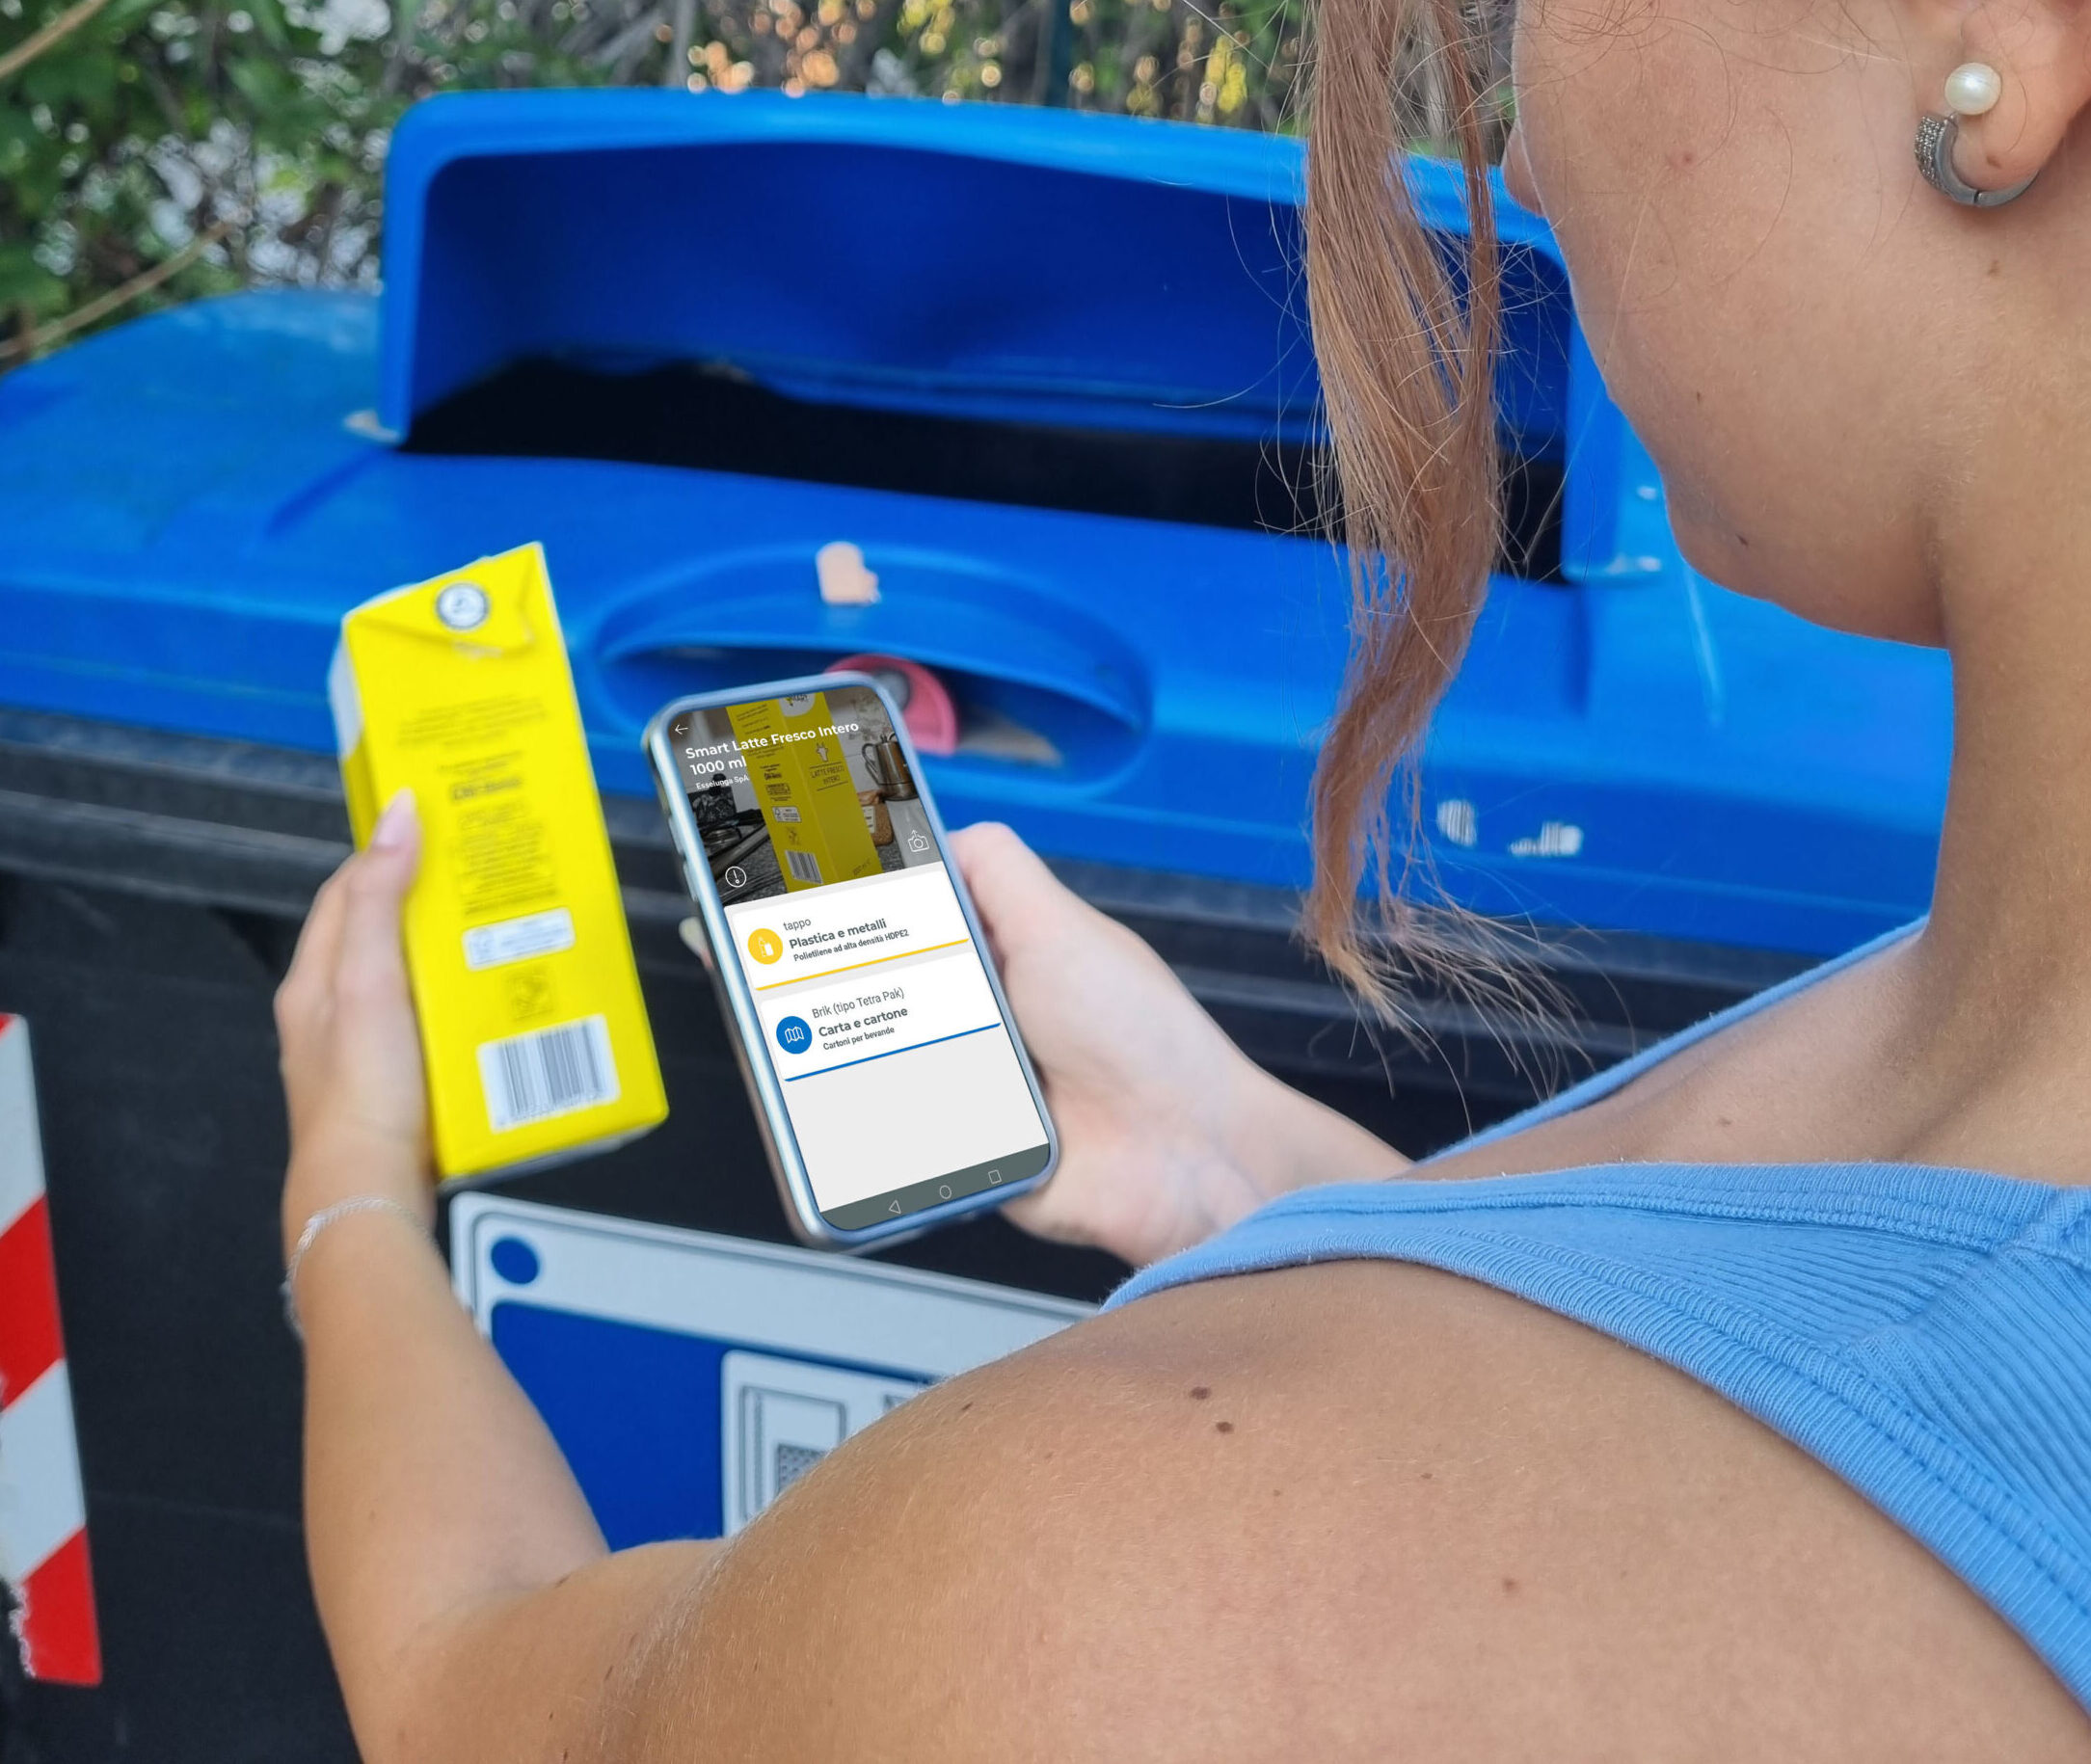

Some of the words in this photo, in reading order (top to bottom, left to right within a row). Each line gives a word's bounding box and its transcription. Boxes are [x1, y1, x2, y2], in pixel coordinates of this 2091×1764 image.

[685, 742, 730, 759] Smart
[732, 737, 768, 751] Latte
[770, 731, 817, 745] Fresco
[818, 723, 859, 736] Intero
[689, 760, 725, 775] 1000
[728, 755, 747, 769] ml
[695, 778, 734, 789] Esselunga
[734, 774, 749, 784] SpA
[783, 919, 812, 931] tappo
[789, 932, 836, 949] Plastica
[847, 918, 887, 936] metalli
[833, 944, 843, 952] ad
[844, 942, 857, 950] alta
[858, 935, 884, 947] densità
[884, 928, 909, 941] HDPE2
[812, 1004, 832, 1019] Brik
[833, 1002, 856, 1015] (tipo
[856, 995, 882, 1007] Tetra
[882, 986, 904, 1002] Pak)
[818, 1022, 852, 1036] Carta
[863, 1008, 908, 1026] cartone
[822, 1037, 851, 1051] Cartoni
[851, 1034, 863, 1045] per
[864, 1026, 895, 1040] bevande
